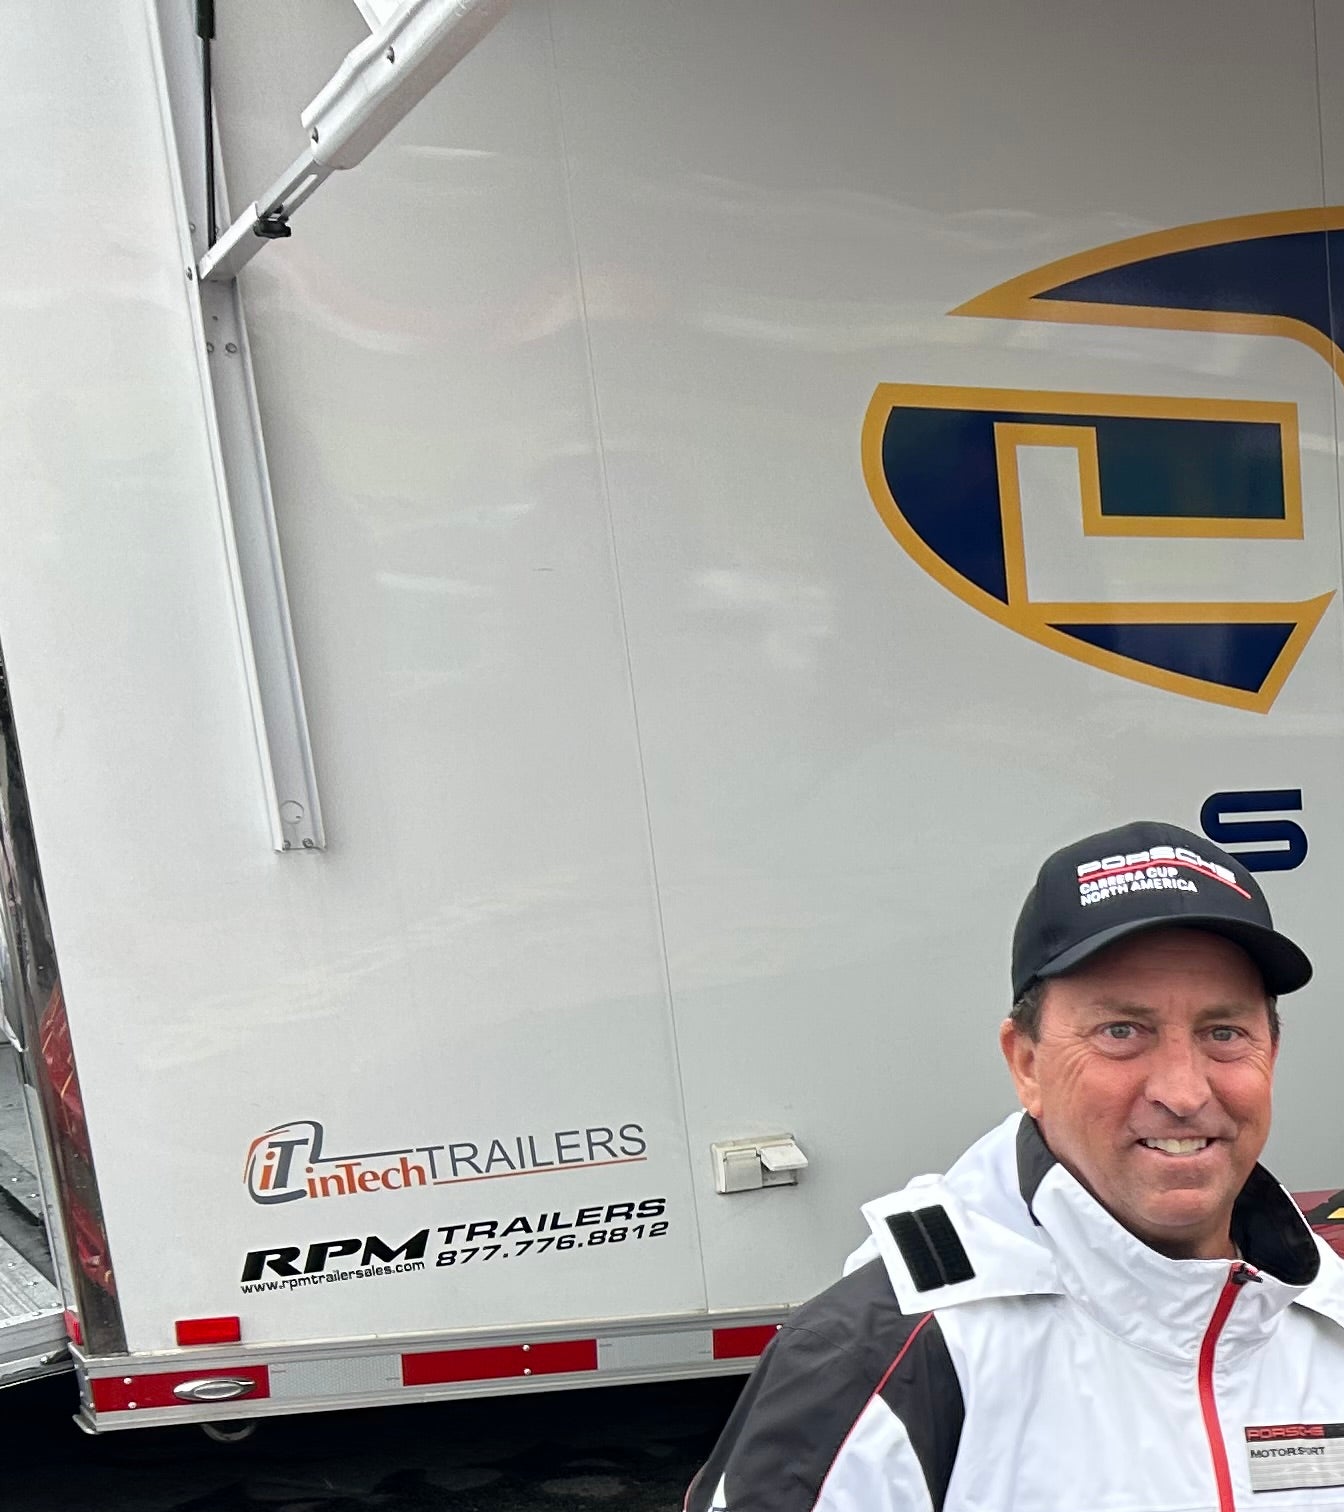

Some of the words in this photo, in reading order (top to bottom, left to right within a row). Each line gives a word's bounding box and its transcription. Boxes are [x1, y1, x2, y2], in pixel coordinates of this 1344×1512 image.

[1077, 846, 1237, 884] PORSCHE
[1080, 870, 1146, 895] CARRERA
[1146, 867, 1179, 879] CUP
[1080, 884, 1130, 907] NORTH
[1130, 878, 1199, 894] AMERICA
[241, 1228, 431, 1283] RPM
[436, 1198, 667, 1245] TRAILERS
[435, 1220, 670, 1268] 877.776.8812
[240, 1260, 426, 1294] www.rpmtrailersales.com
[1246, 1425, 1325, 1441] PORSCHE
